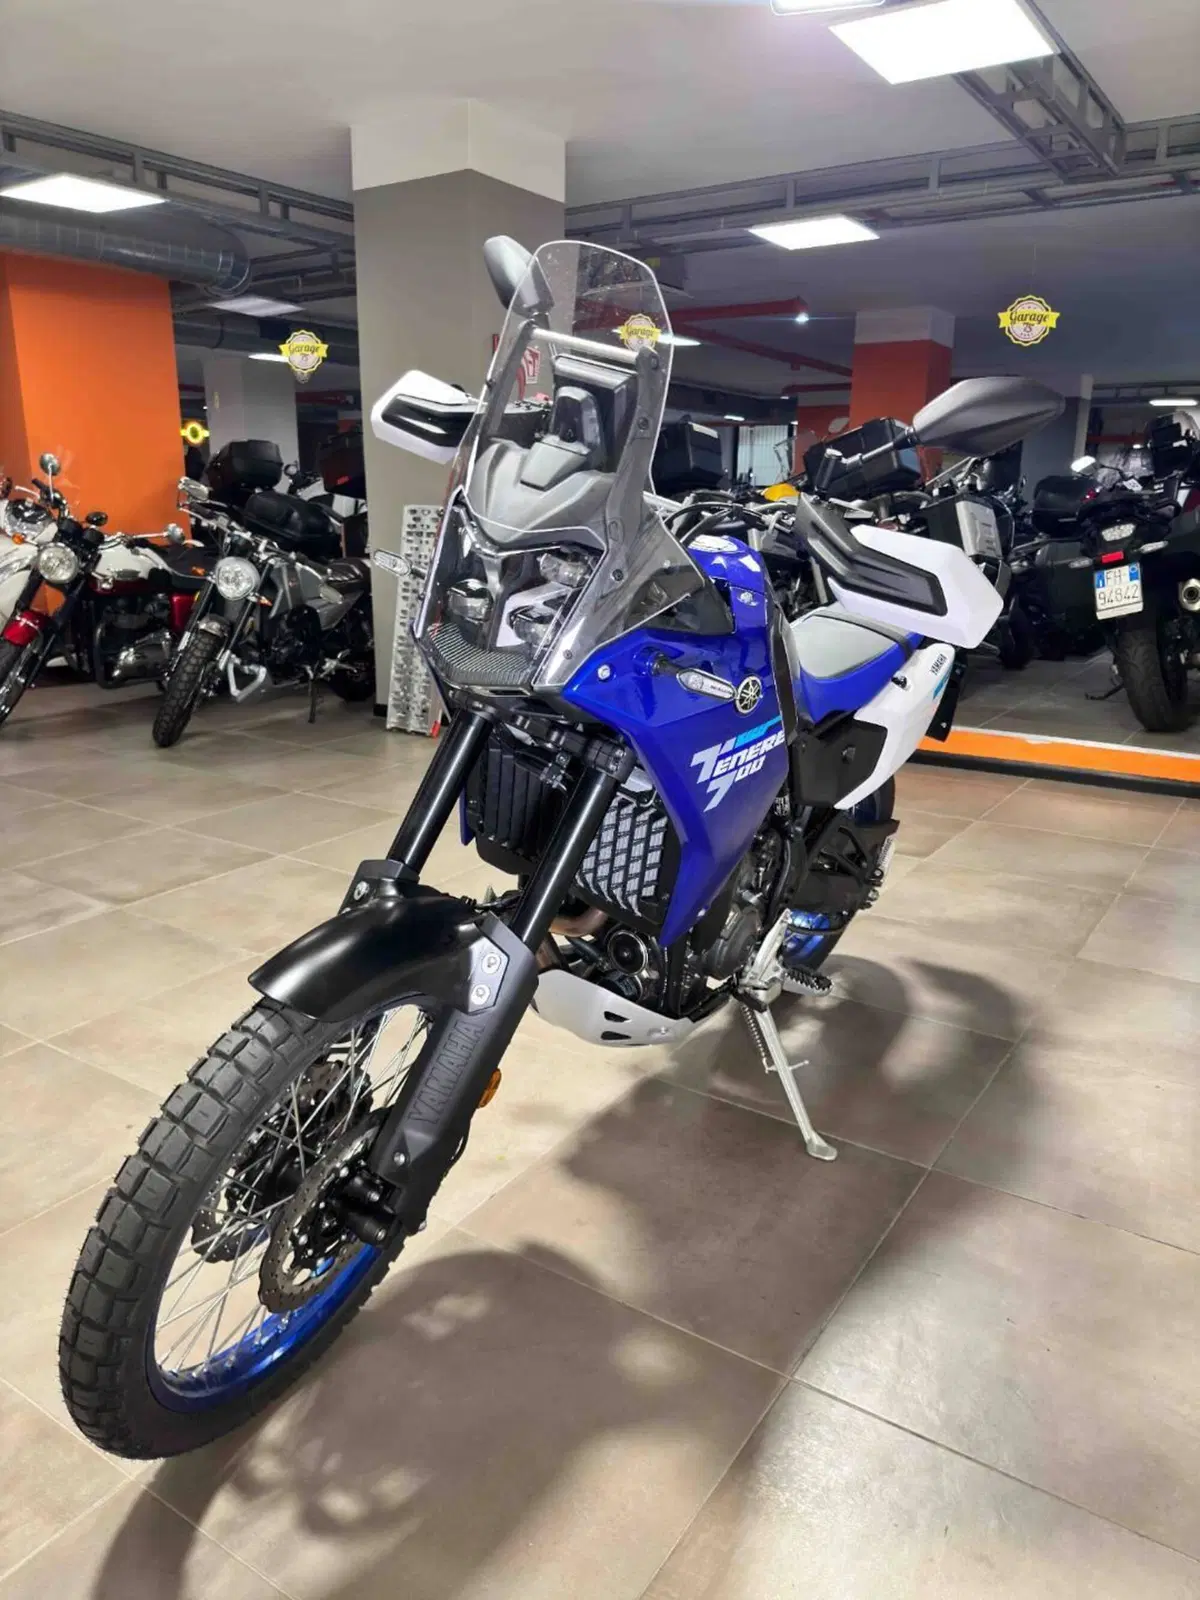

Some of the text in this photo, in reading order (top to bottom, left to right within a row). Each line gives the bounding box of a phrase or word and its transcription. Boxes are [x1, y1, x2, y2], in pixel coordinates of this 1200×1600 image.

[1009, 311, 1050, 325] Garage
[1105, 569, 1122, 586] FH
[1098, 583, 1139, 606] 94842
[703, 754, 767, 813] 700
[407, 1020, 486, 1125] YAMAHA
